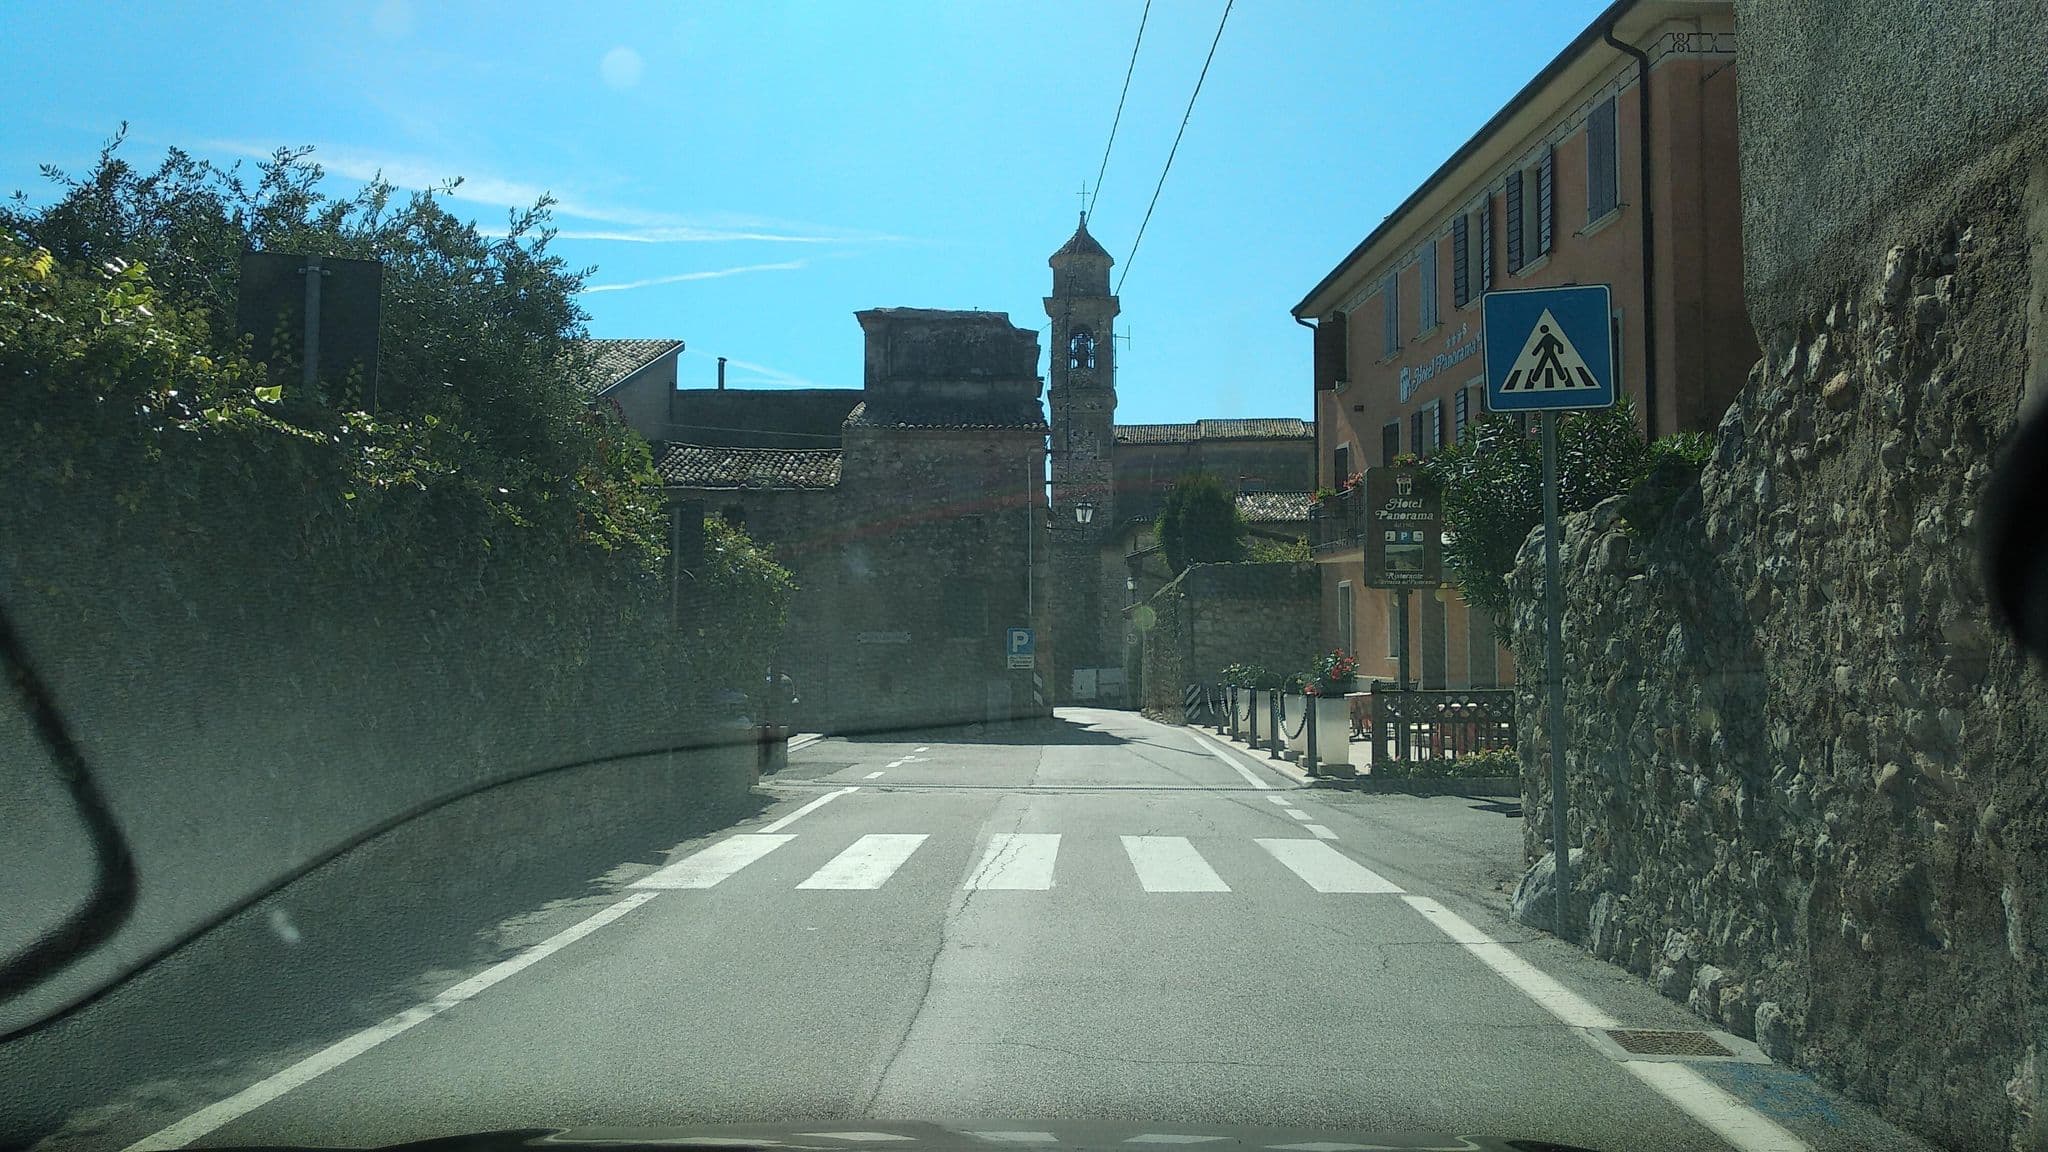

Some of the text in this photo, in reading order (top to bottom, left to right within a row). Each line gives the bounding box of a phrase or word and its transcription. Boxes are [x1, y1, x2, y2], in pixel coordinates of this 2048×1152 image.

[1411, 356, 1436, 393] Hotel
[1385, 498, 1423, 510] Hotel
[1375, 509, 1434, 520] Panorama
[1401, 531, 1408, 541] P
[1012, 630, 1029, 653] P
